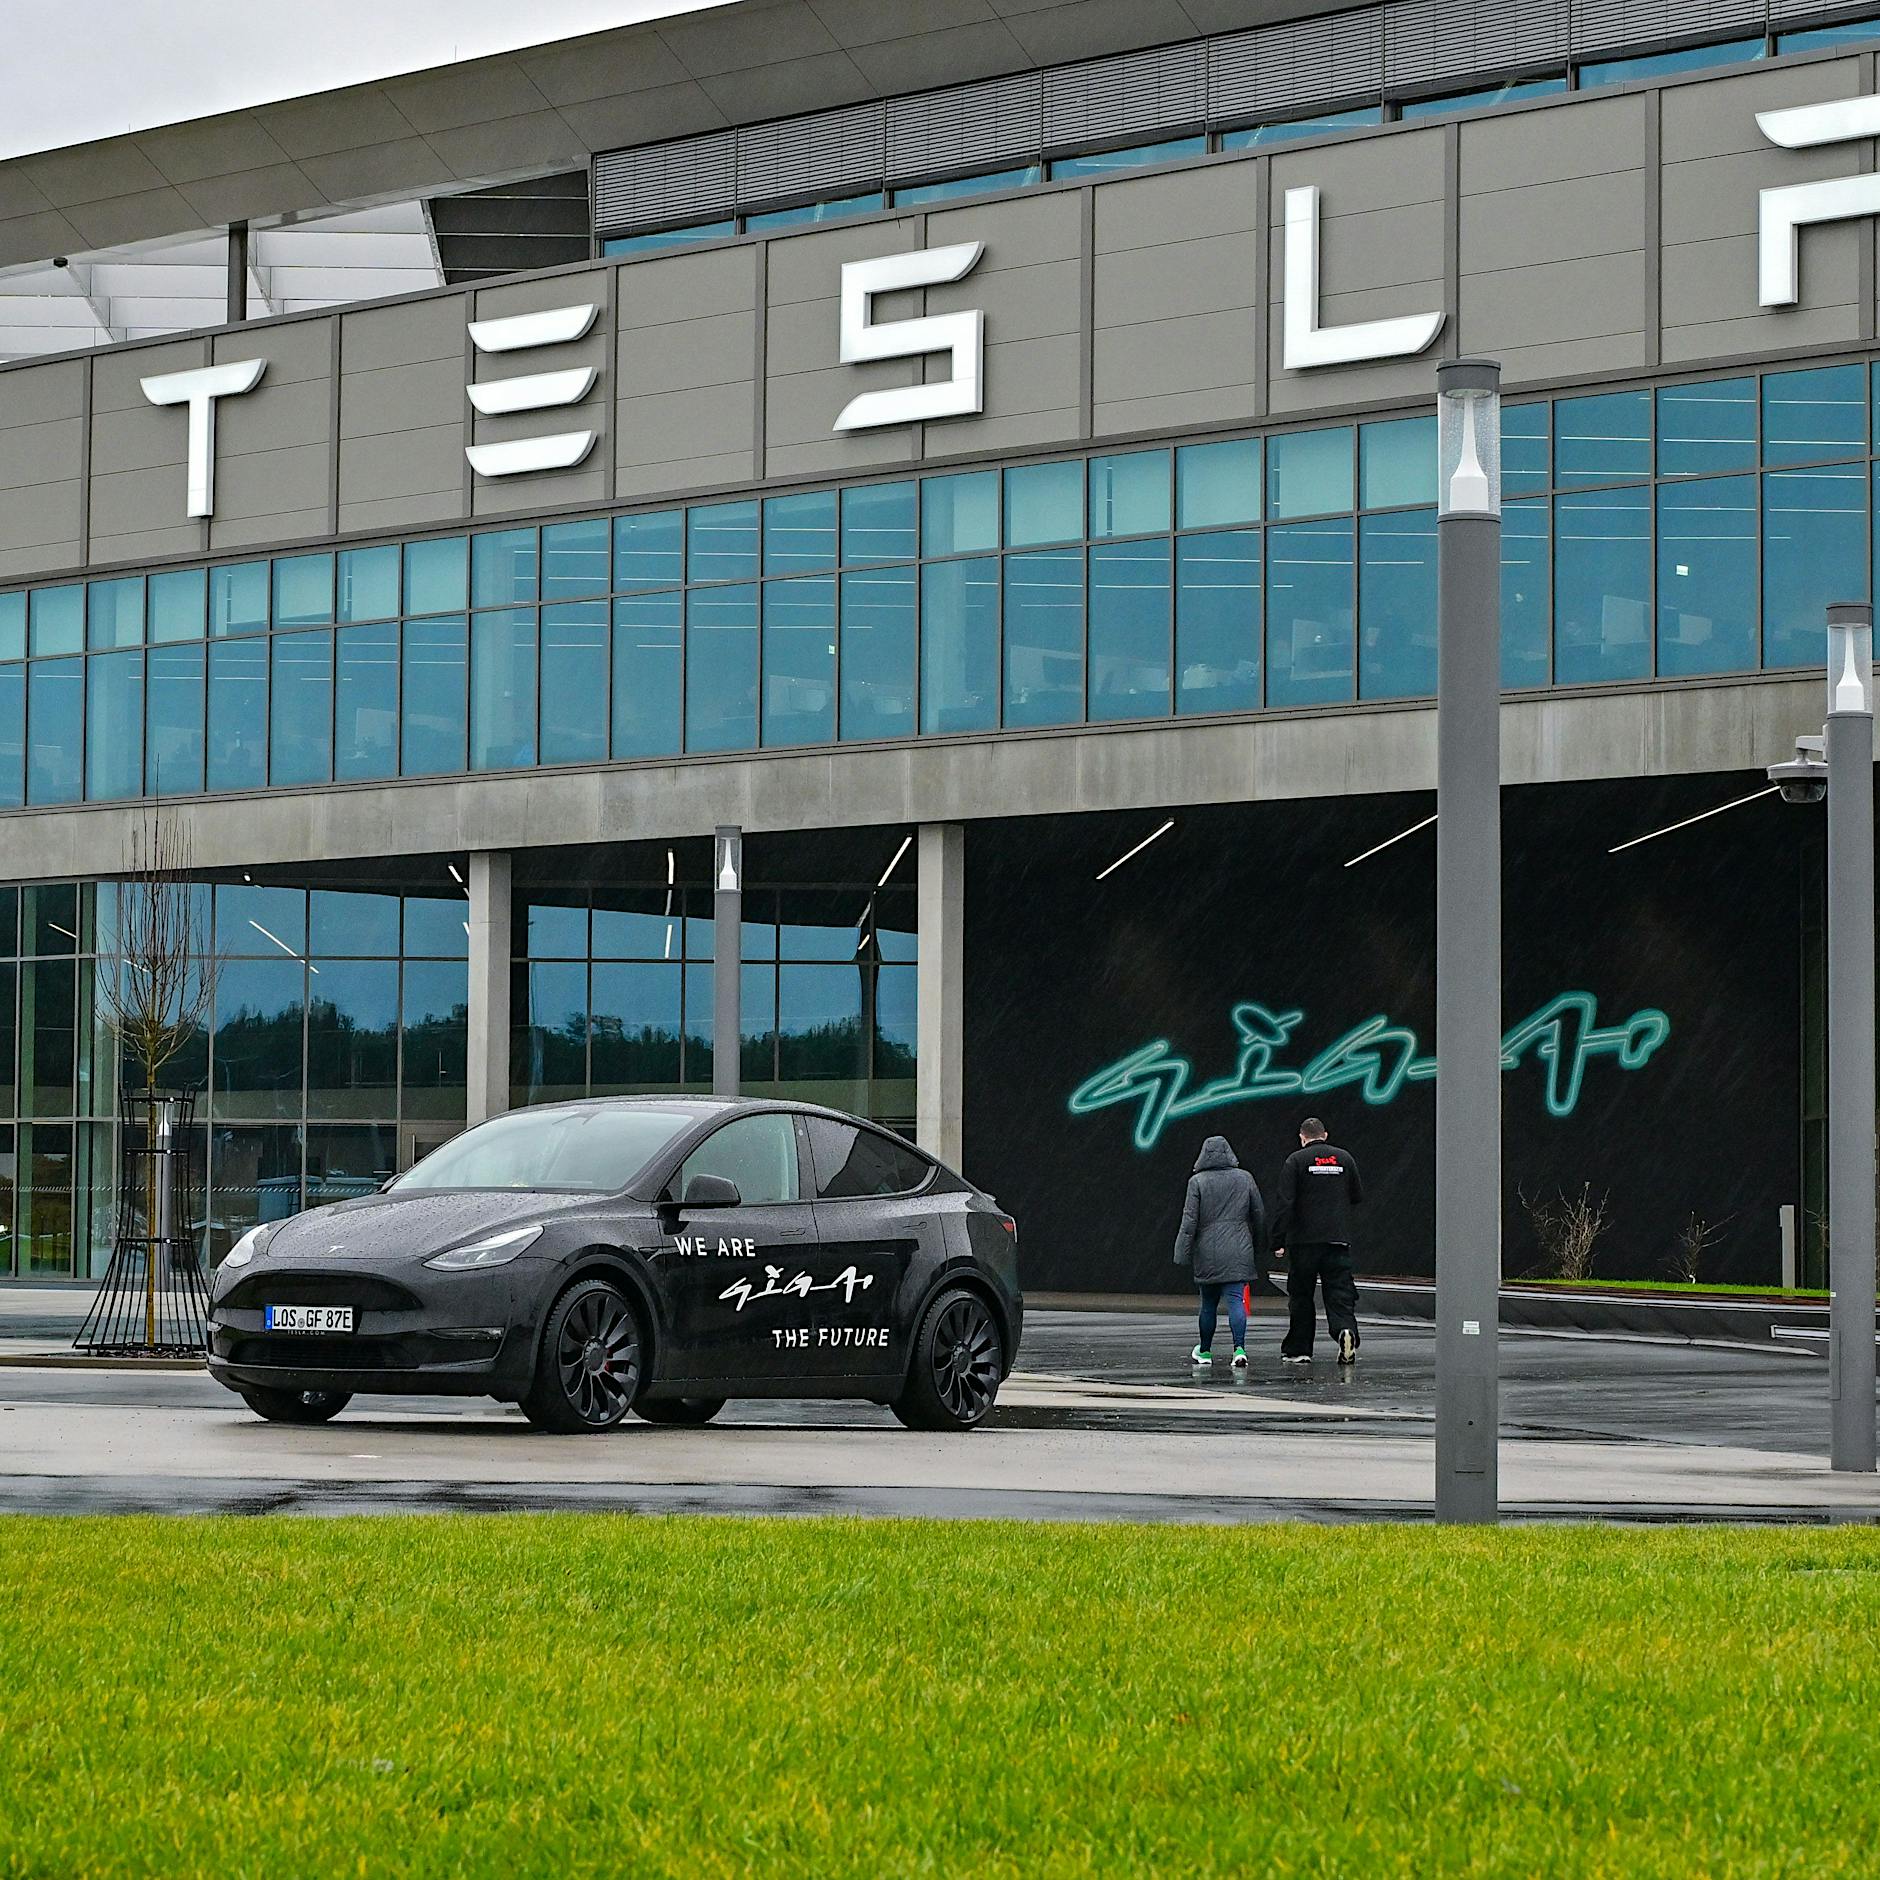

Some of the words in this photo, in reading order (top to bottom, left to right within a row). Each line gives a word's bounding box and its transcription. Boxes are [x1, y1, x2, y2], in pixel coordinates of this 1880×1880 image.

[674, 1236, 707, 1256] WE
[717, 1237, 756, 1257] ARE
[273, 1309, 297, 1327] LOS
[306, 1309, 323, 1328] GF
[326, 1310, 351, 1329] 87E
[772, 1329, 809, 1348] THE
[818, 1328, 890, 1347] FUTURE
